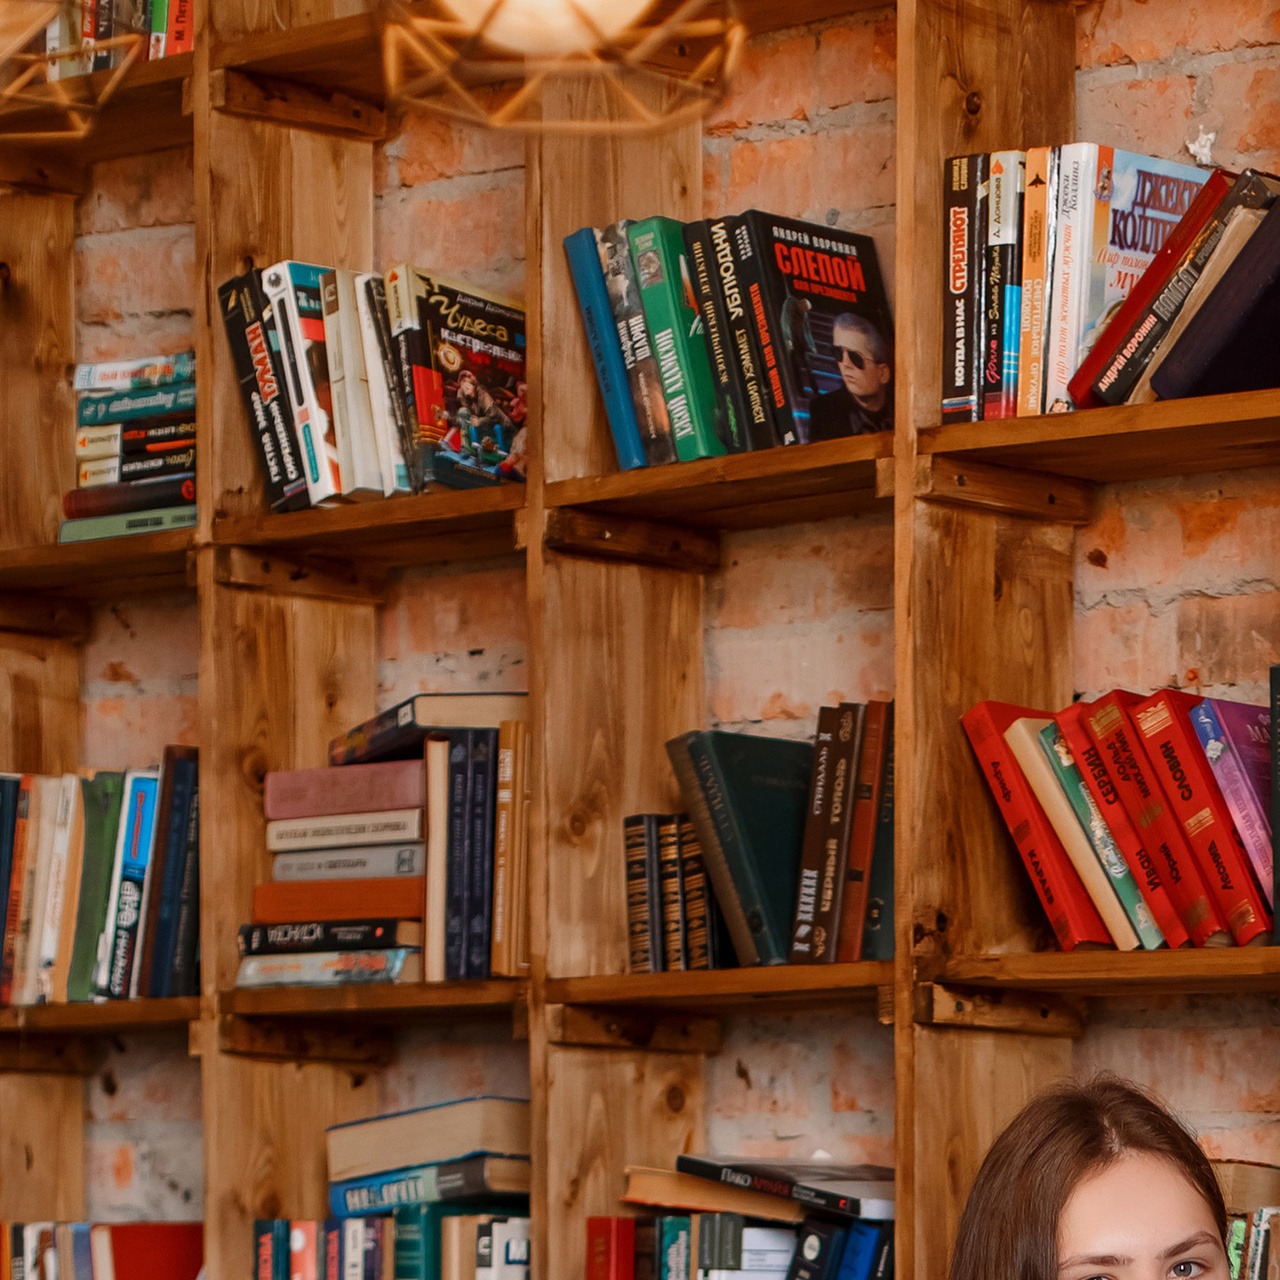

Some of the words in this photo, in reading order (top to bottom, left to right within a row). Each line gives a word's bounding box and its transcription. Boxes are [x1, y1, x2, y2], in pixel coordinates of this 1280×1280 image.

[993, 177, 1002, 226] Донцова
[1061, 174, 1071, 219] Джеки
[1068, 160, 1080, 212] Коллинз
[710, 221, 746, 321] УБЛЮДКИ
[774, 242, 867, 293] СЛЕПОЙ
[950, 206, 968, 294] СТРЕЛЯЮТ
[954, 298, 967, 327] НАС
[1153, 263, 1200, 321] КОМБАТ
[245, 320, 281, 404] ТУМАН
[655, 327, 685, 392] АДАМСОН
[734, 328, 756, 379] ХЭММЕТ
[954, 339, 967, 387] КОГДА
[1097, 354, 1130, 392] АНДРЕЙ
[1123, 313, 1158, 361] ВОРОНИН
[745, 380, 767, 425] ДЭШИЛ
[1082, 745, 1119, 806] СЕРБИН
[1158, 740, 1194, 802] СЛОВИН
